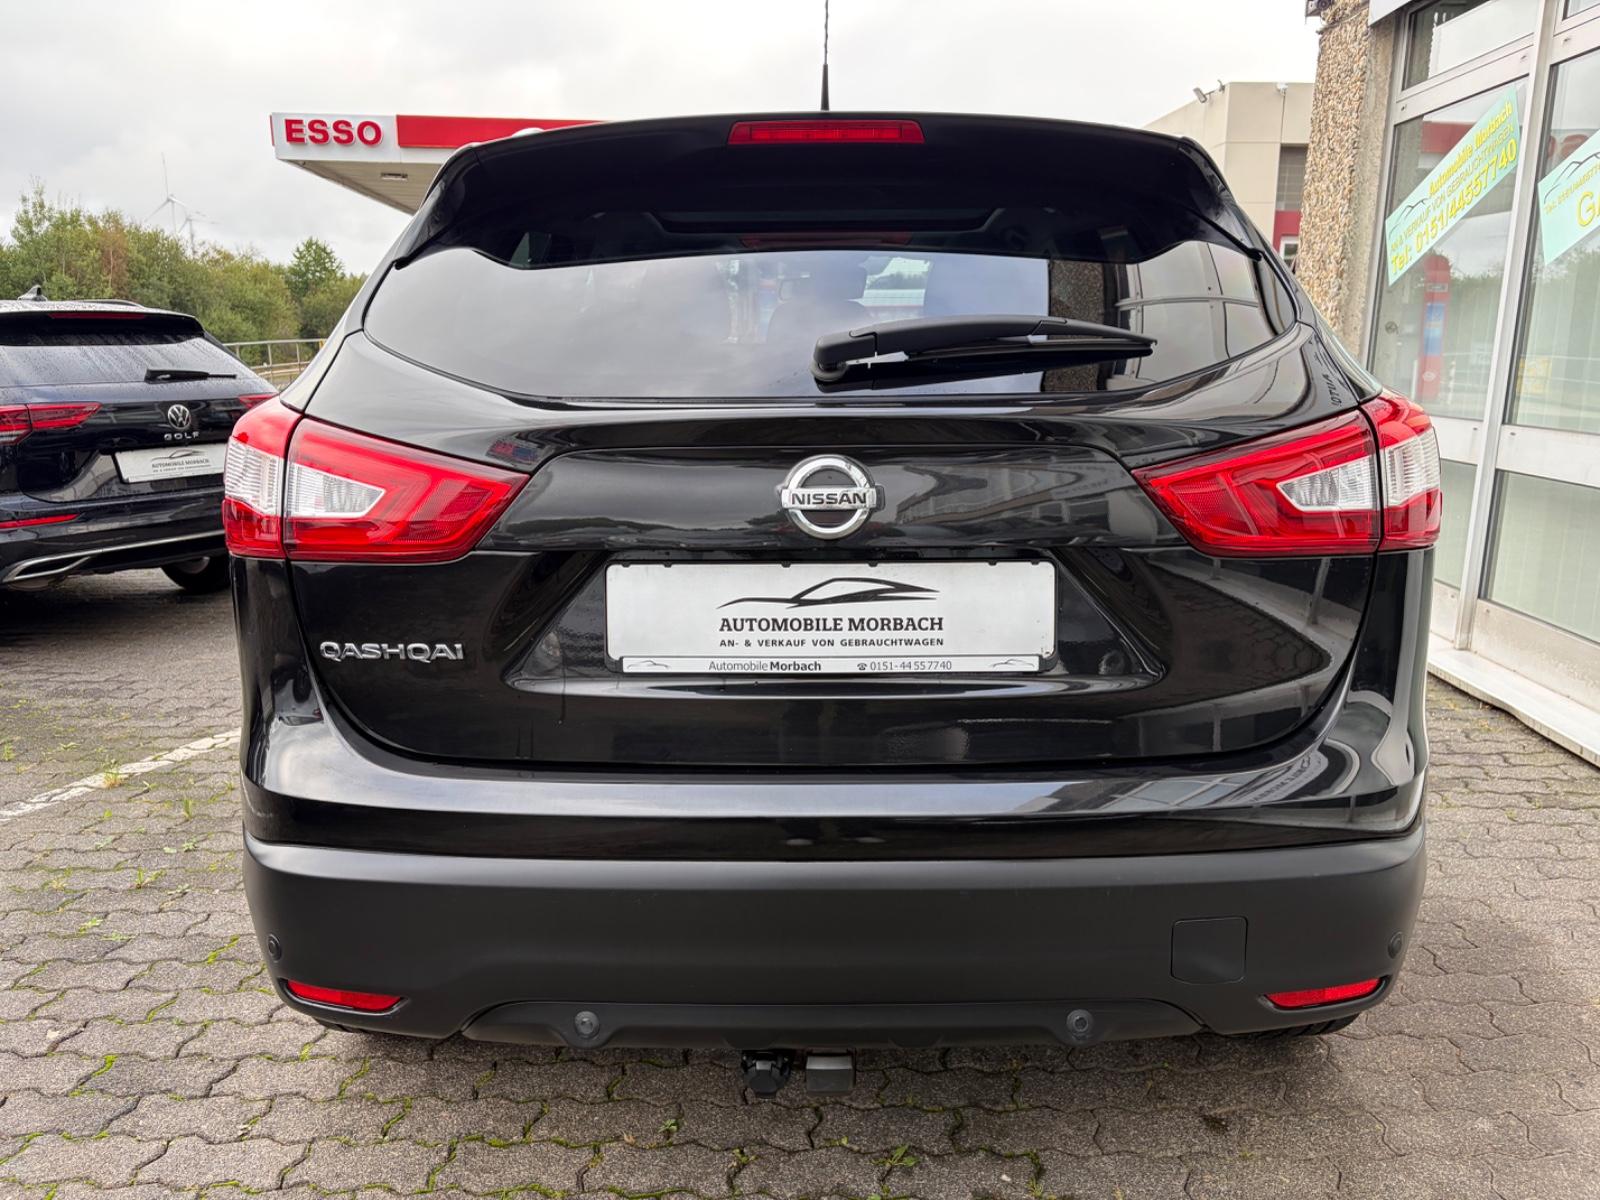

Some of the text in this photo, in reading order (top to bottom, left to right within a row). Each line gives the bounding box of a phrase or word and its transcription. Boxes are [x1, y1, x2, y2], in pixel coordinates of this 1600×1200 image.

[284, 118, 383, 146] ESSO
[1415, 138, 1517, 253] 0151/44557740
[164, 431, 200, 440] GOLF
[791, 492, 867, 505] NISSAN
[719, 617, 944, 632] AUTOMOBILE MORBACH
[719, 638, 944, 647] AN- & VERKAUF VON GEBRAUCHTWAGEN
[319, 641, 465, 663] QASHQAI
[769, 661, 822, 671] Morbach
